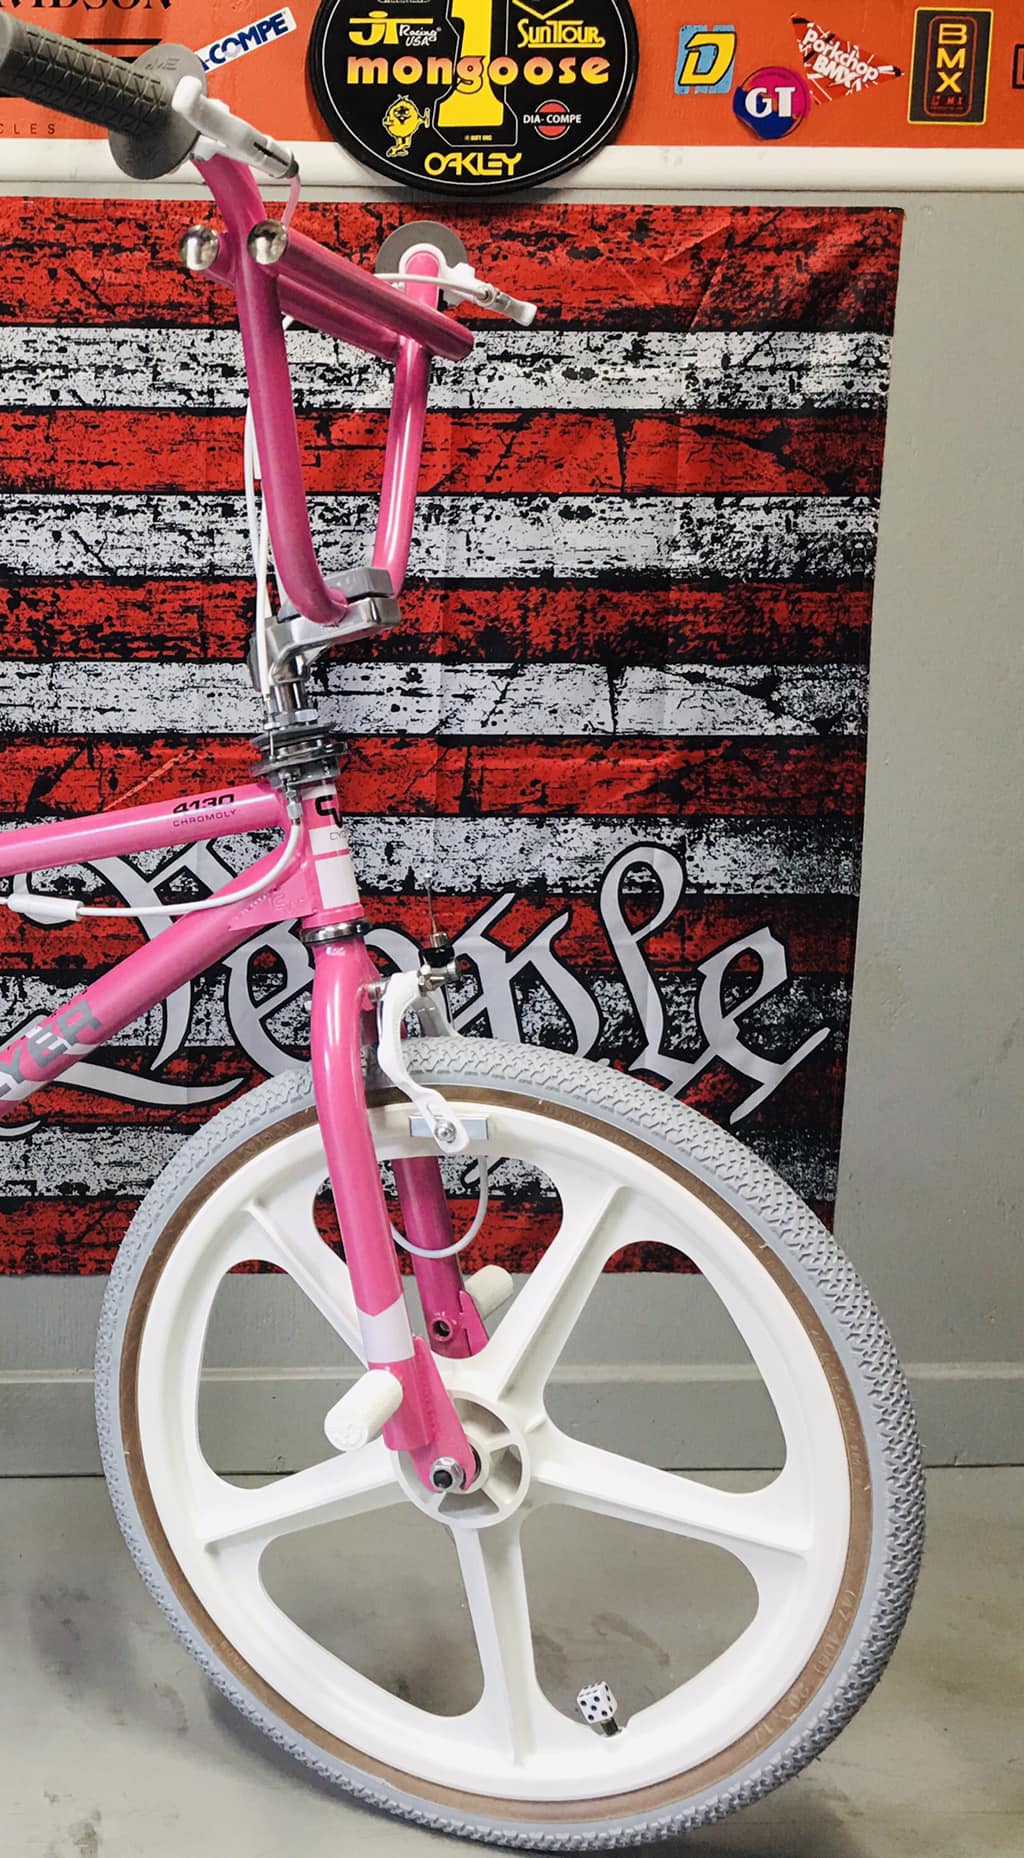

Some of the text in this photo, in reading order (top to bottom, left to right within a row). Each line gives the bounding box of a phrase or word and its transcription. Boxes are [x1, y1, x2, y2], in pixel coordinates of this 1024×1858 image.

[405, 36, 430, 47] USA
[802, 28, 879, 83] Porkchop
[936, 24, 968, 93] BMX
[347, 56, 610, 94] mongoose
[745, 87, 796, 118] GT
[424, 152, 522, 176] OAKLEY
[172, 809, 237, 827] CHROMOLY
